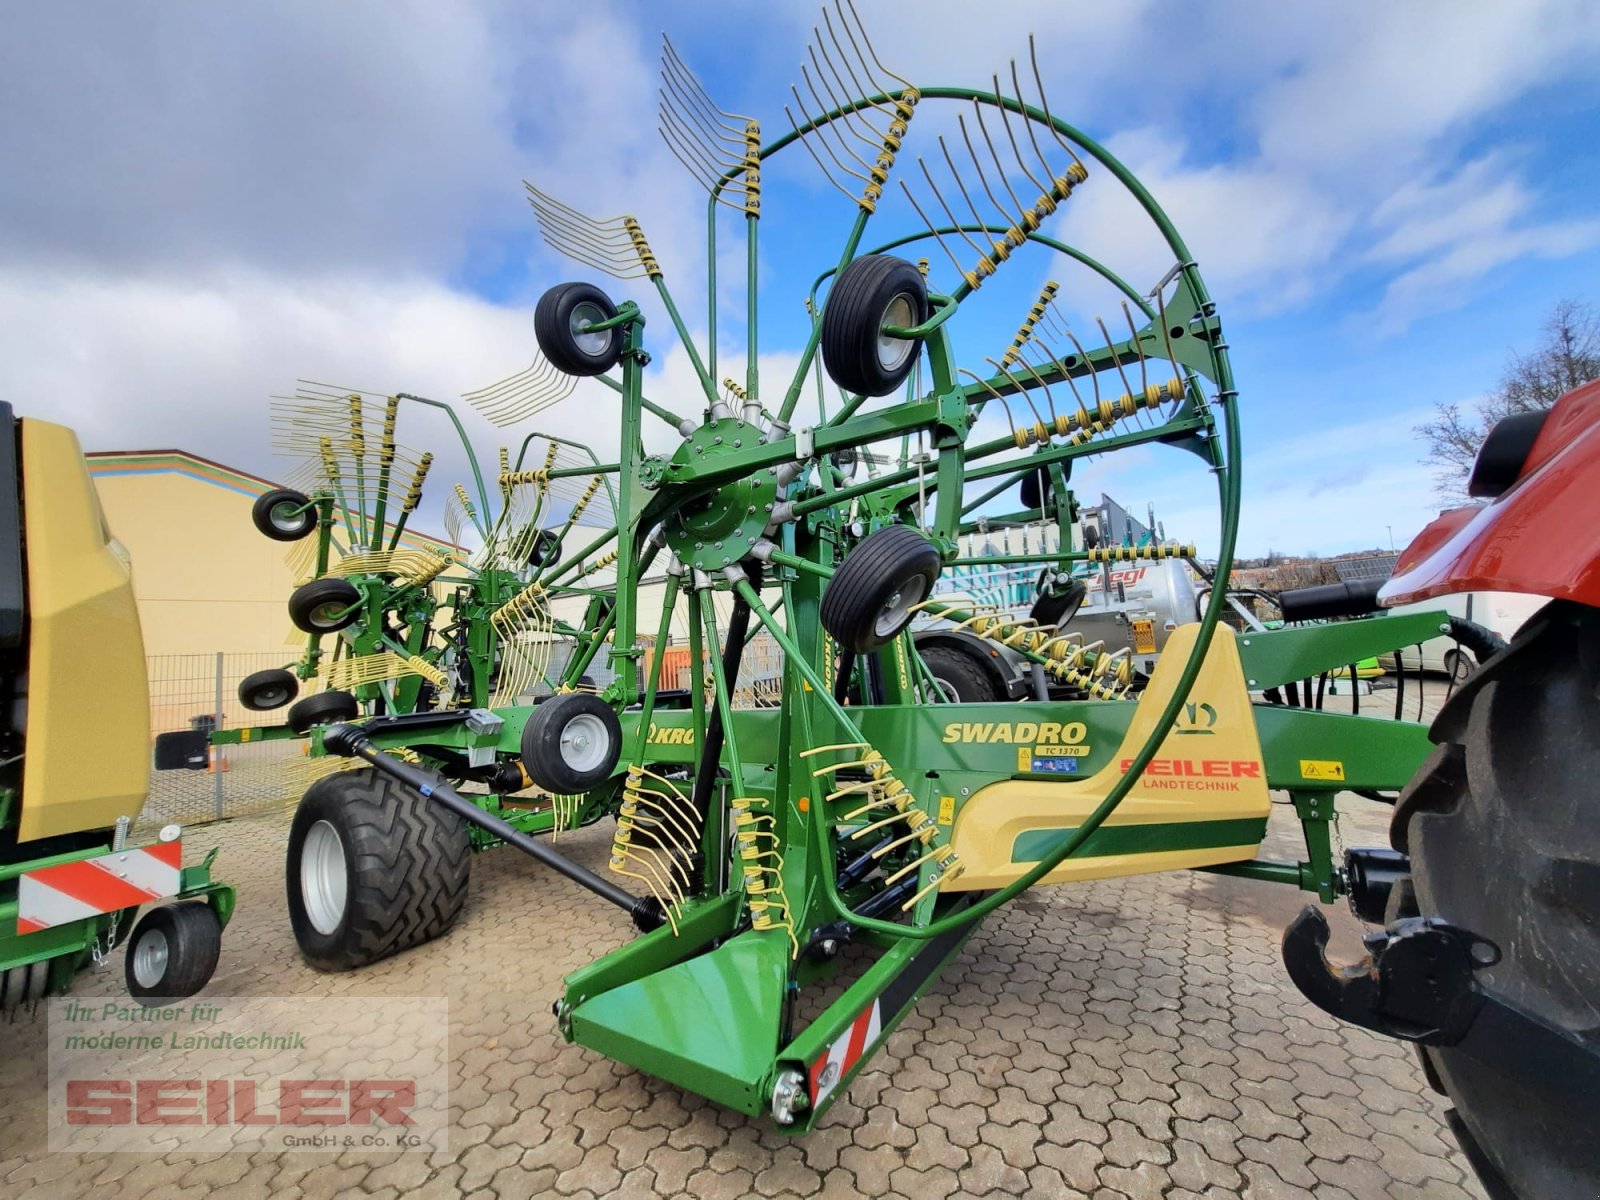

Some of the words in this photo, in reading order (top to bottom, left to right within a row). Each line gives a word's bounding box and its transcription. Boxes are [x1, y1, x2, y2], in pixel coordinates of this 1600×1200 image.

[895, 634, 906, 675] KRON
[654, 727, 726, 745] KRO
[942, 721, 1088, 744] SWADRO
[1045, 747, 1056, 755] TC
[1058, 747, 1080, 755] 1370
[1143, 780, 1240, 791] LANDTECHNIK
